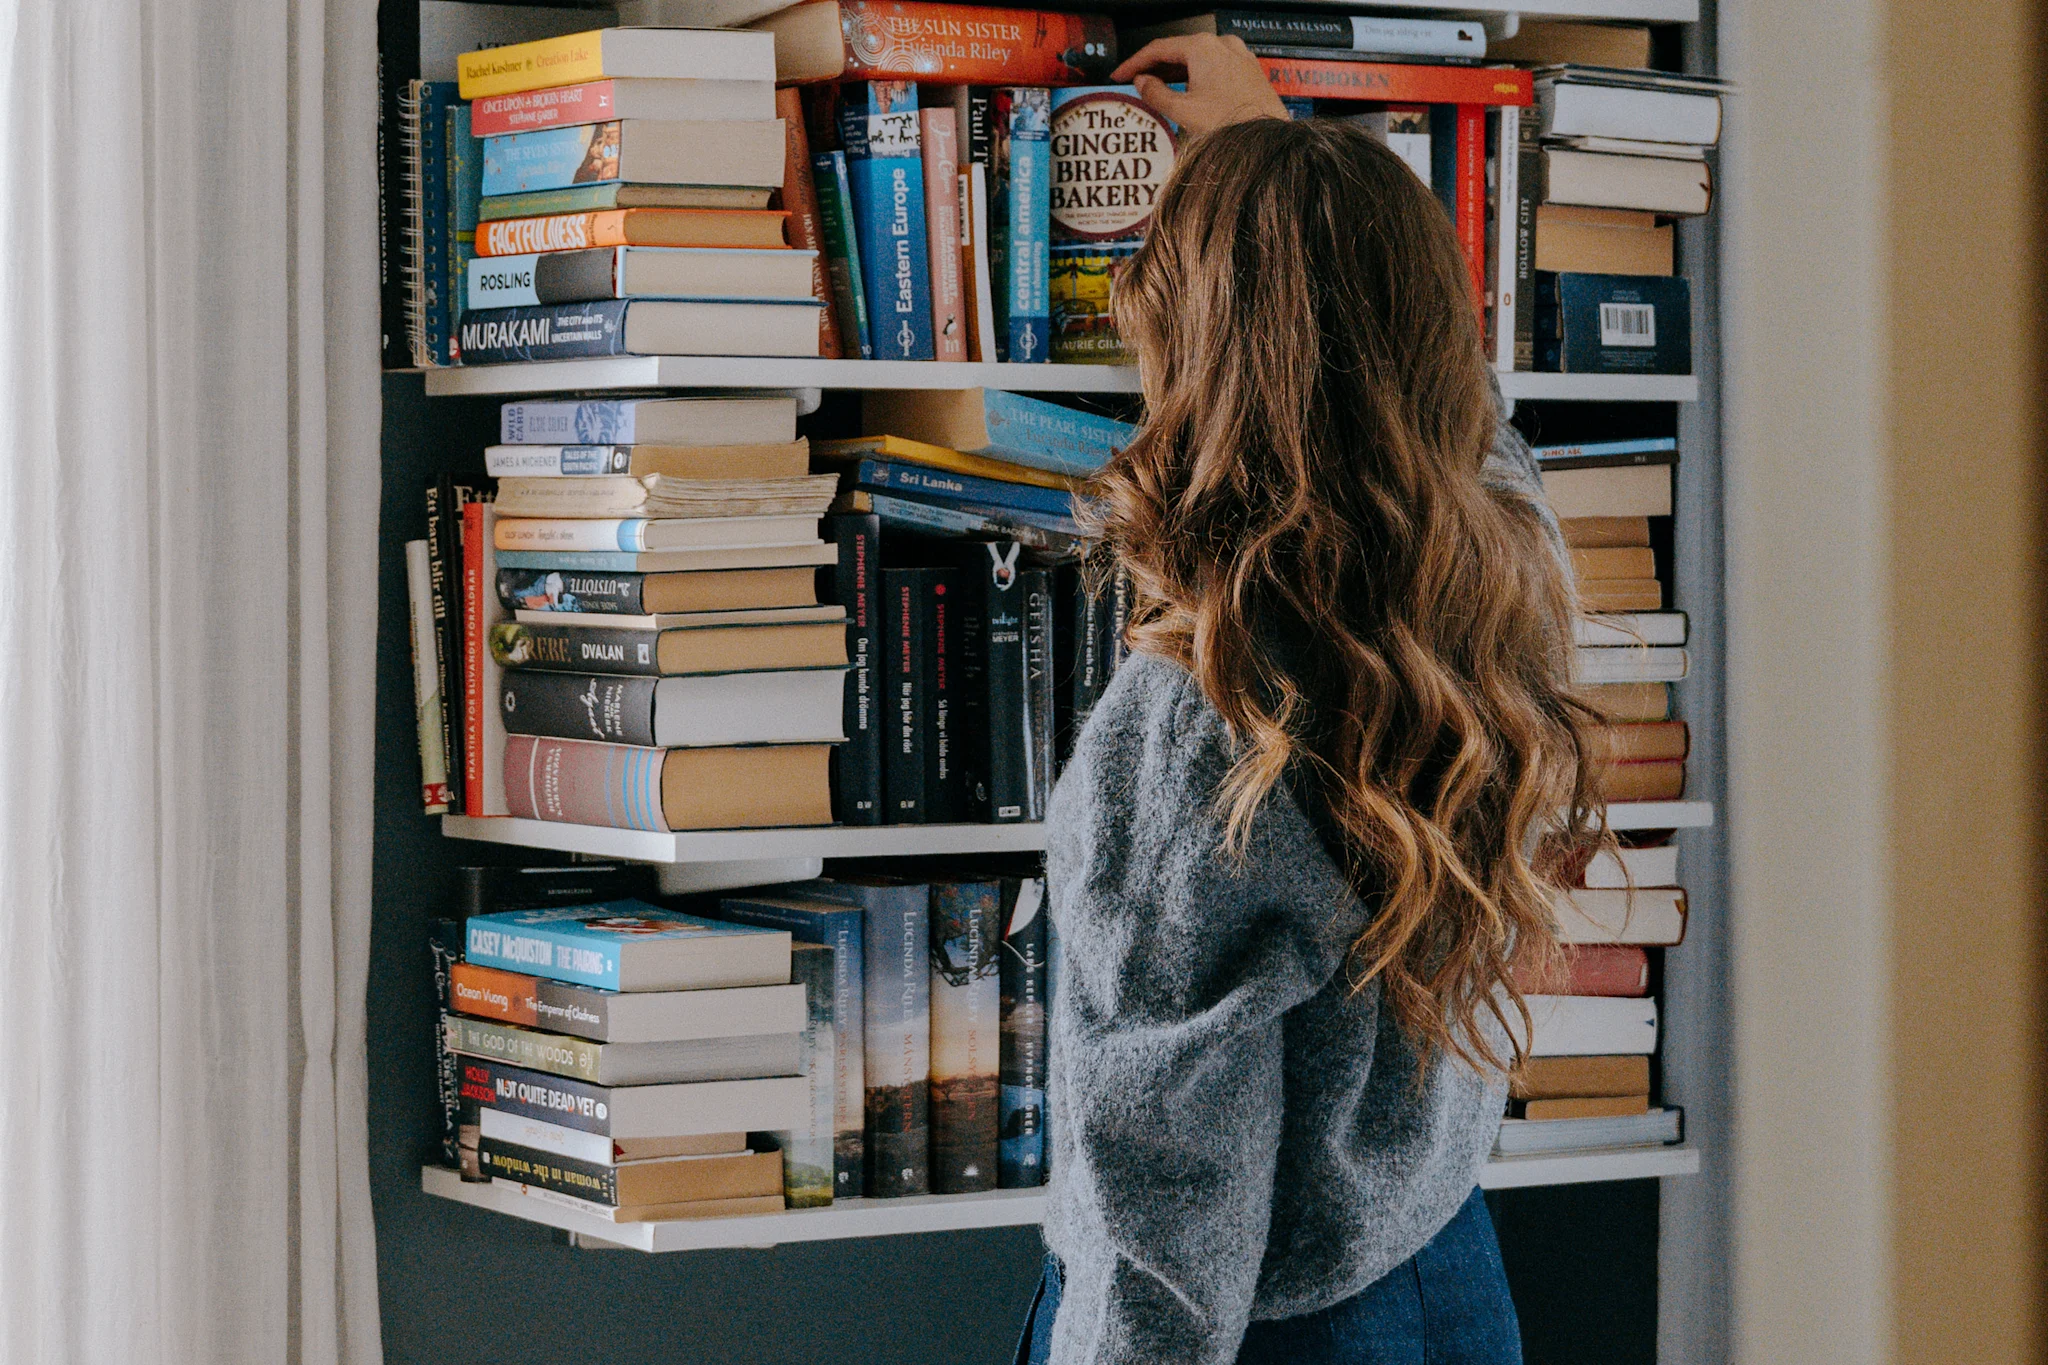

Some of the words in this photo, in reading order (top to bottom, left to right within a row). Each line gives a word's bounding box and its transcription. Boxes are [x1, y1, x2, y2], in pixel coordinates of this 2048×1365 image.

[888, 16, 920, 34] THE
[923, 18, 961, 37] SUN
[965, 21, 1022, 41] SISTER
[466, 66, 491, 80] Rachel
[491, 60, 523, 76] Kushner
[535, 53, 570, 69] Creation
[571, 48, 589, 63] Lake
[900, 38, 966, 59] Lucinda
[970, 43, 1011, 66] Riley
[1269, 66, 1390, 88] RYMDBOKEN
[482, 99, 503, 114] ONCE
[560, 88, 583, 103] HEART
[971, 97, 988, 141] Paul
[1083, 109, 1126, 129] The
[1050, 131, 1159, 158] GINGER
[1056, 157, 1152, 183] BREAD
[891, 167, 910, 236] Europe
[1013, 156, 1031, 237] america
[1049, 183, 1160, 210] BAKERY
[803, 213, 815, 233] DEN
[1520, 197, 1530, 225] CITY
[488, 214, 587, 255] FACTFULNESS
[1519, 228, 1529, 279] HOLLOW
[480, 271, 531, 291] ROSLING
[895, 239, 913, 313] Eastern
[1013, 240, 1030, 311] central
[462, 318, 550, 350] MURAKAMI
[557, 316, 569, 328] THE
[568, 315, 582, 327] CITY
[592, 313, 604, 325] ITS
[551, 331, 583, 344] UNCERTAIN
[582, 330, 603, 342] WALLS
[1055, 339, 1095, 351] LAURIE
[507, 408, 516, 440] WILD
[516, 406, 524, 442] CARD
[1011, 408, 1037, 427] THE
[1039, 413, 1076, 435] PEARL
[493, 456, 515, 468] JAMES
[520, 456, 557, 468] MICHENER
[1542, 449, 1566, 457] DINO
[900, 472, 921, 485] Sri
[922, 474, 963, 493] Lanka
[426, 487, 439, 513] Ett
[428, 514, 440, 557] barn
[855, 533, 866, 590] STEPHENIE
[430, 559, 444, 593] blir
[433, 594, 446, 620] till
[856, 592, 867, 628] MEYER
[901, 586, 910, 638] STEPHENIE
[857, 637, 869, 653] Om
[992, 635, 1019, 643] MEYER
[1029, 591, 1042, 680] GEISHA
[1086, 623, 1095, 646] Natt
[581, 643, 624, 661] DVALAN
[855, 653, 869, 667] jag
[902, 640, 911, 673] MEYER
[1086, 646, 1095, 665] och
[467, 640, 476, 695] BLIVANDE
[858, 667, 870, 694] kunde
[1083, 666, 1094, 687] Dag
[604, 685, 614, 733] NIEKERK
[614, 684, 624, 736] MARLENE
[900, 697, 913, 710] jag
[467, 725, 476, 780] PRAKTIKA
[470, 928, 500, 958] CASEY
[556, 945, 572, 970] THE
[572, 948, 604, 976] PAIRING
[902, 911, 917, 978] LUCINDA
[968, 908, 983, 976] LUCINDA
[838, 930, 849, 986] LUCINDA
[1025, 942, 1035, 973] LARS
[456, 982, 482, 1001] Ocean
[482, 987, 509, 1013] Vuong
[525, 996, 538, 1011] The
[537, 1000, 565, 1018] Emperor
[564, 1004, 572, 1021] of
[572, 1006, 600, 1025] Gladness
[838, 988, 848, 1025] RILEY
[902, 981, 917, 1025] RILEY
[968, 979, 981, 1021] RILEY
[1025, 978, 1035, 1024] KEPLER
[468, 1029, 480, 1047] THE
[482, 1033, 506, 1051] GOD
[521, 1040, 533, 1057] THE
[536, 1044, 574, 1066] WOODS
[465, 1065, 490, 1084] HOLLY
[459, 1082, 497, 1104] JACKSON
[496, 1077, 518, 1099] NOT
[517, 1082, 547, 1106] QUITE
[548, 1089, 576, 1113] DEAD
[576, 1095, 596, 1117] YET
[492, 1154, 531, 1177] window
[532, 1163, 549, 1183] the
[551, 1167, 563, 1186] in
[563, 1170, 601, 1190] woman
